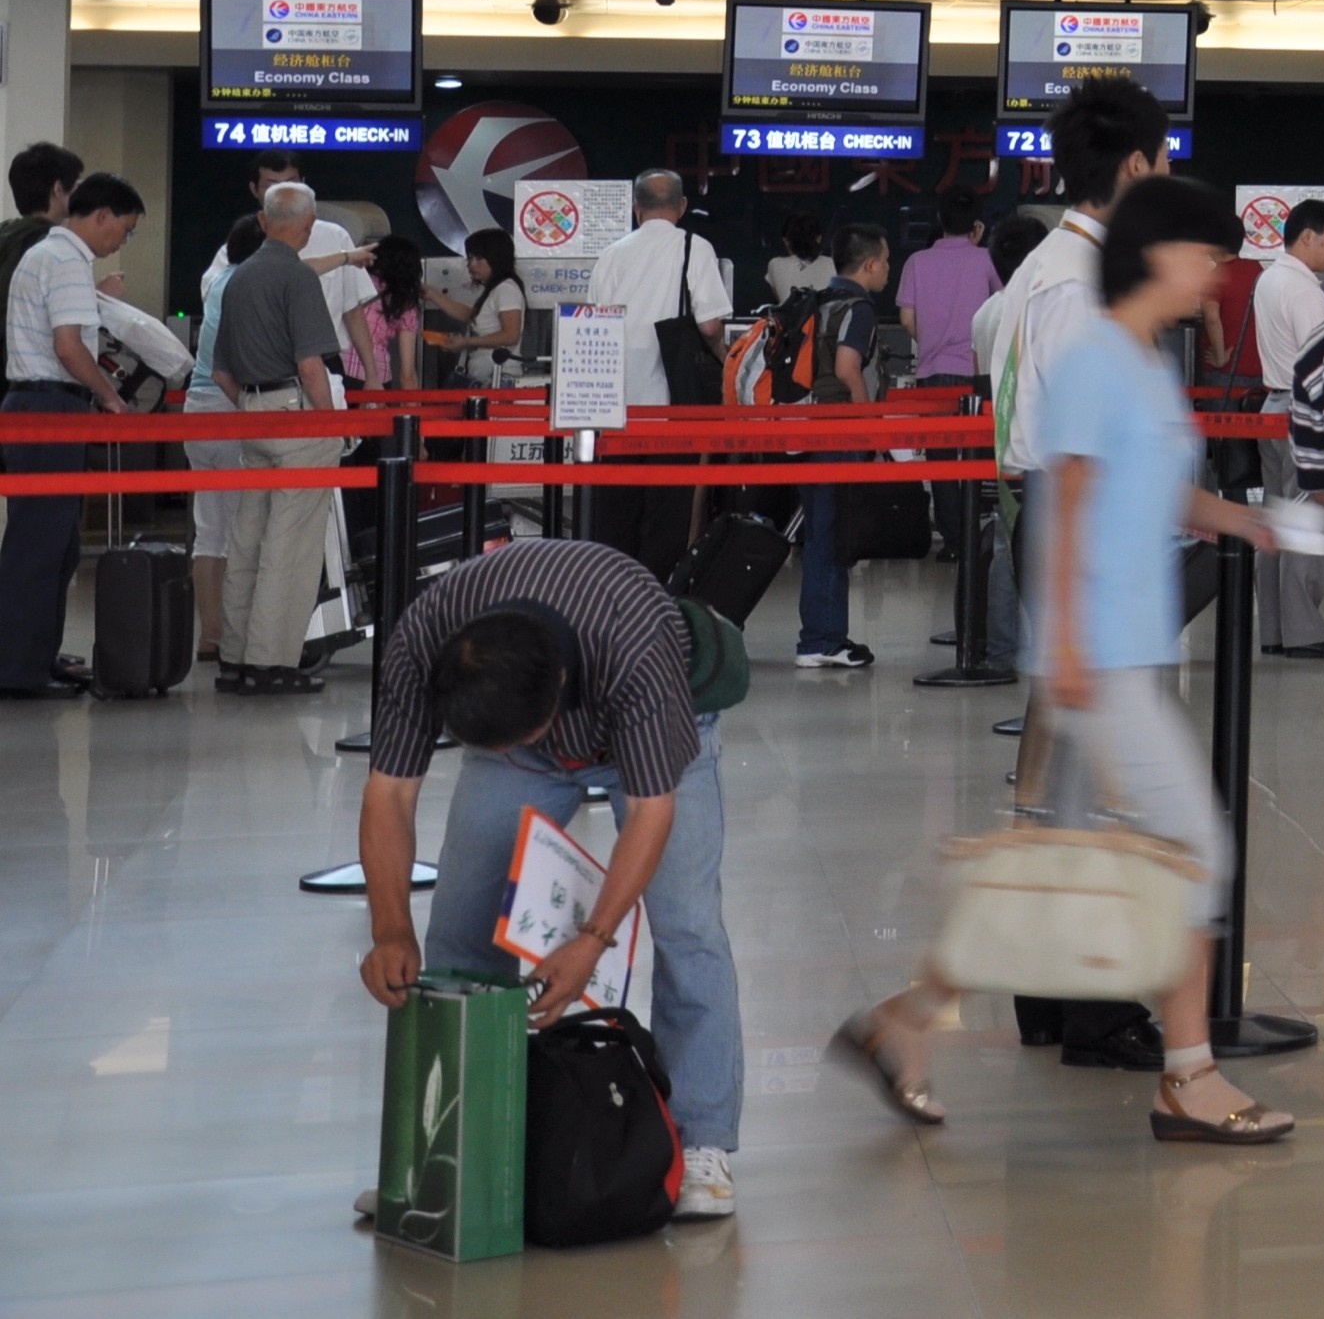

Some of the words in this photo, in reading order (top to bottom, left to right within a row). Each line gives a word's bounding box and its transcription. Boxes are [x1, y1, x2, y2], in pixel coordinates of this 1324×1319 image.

[254, 70, 325, 86] Economy
[328, 72, 370, 84] Class
[771, 80, 836, 95] Economy
[840, 82, 879, 94] Class
[215, 122, 246, 143] 74
[251, 124, 327, 144] 值机柜台
[335, 127, 409, 142] CHECK-IN
[733, 129, 761, 149] 73
[766, 131, 836, 150] 值机柜台
[843, 134, 912, 149] CHECK-IN
[1007, 131, 1034, 151] 72
